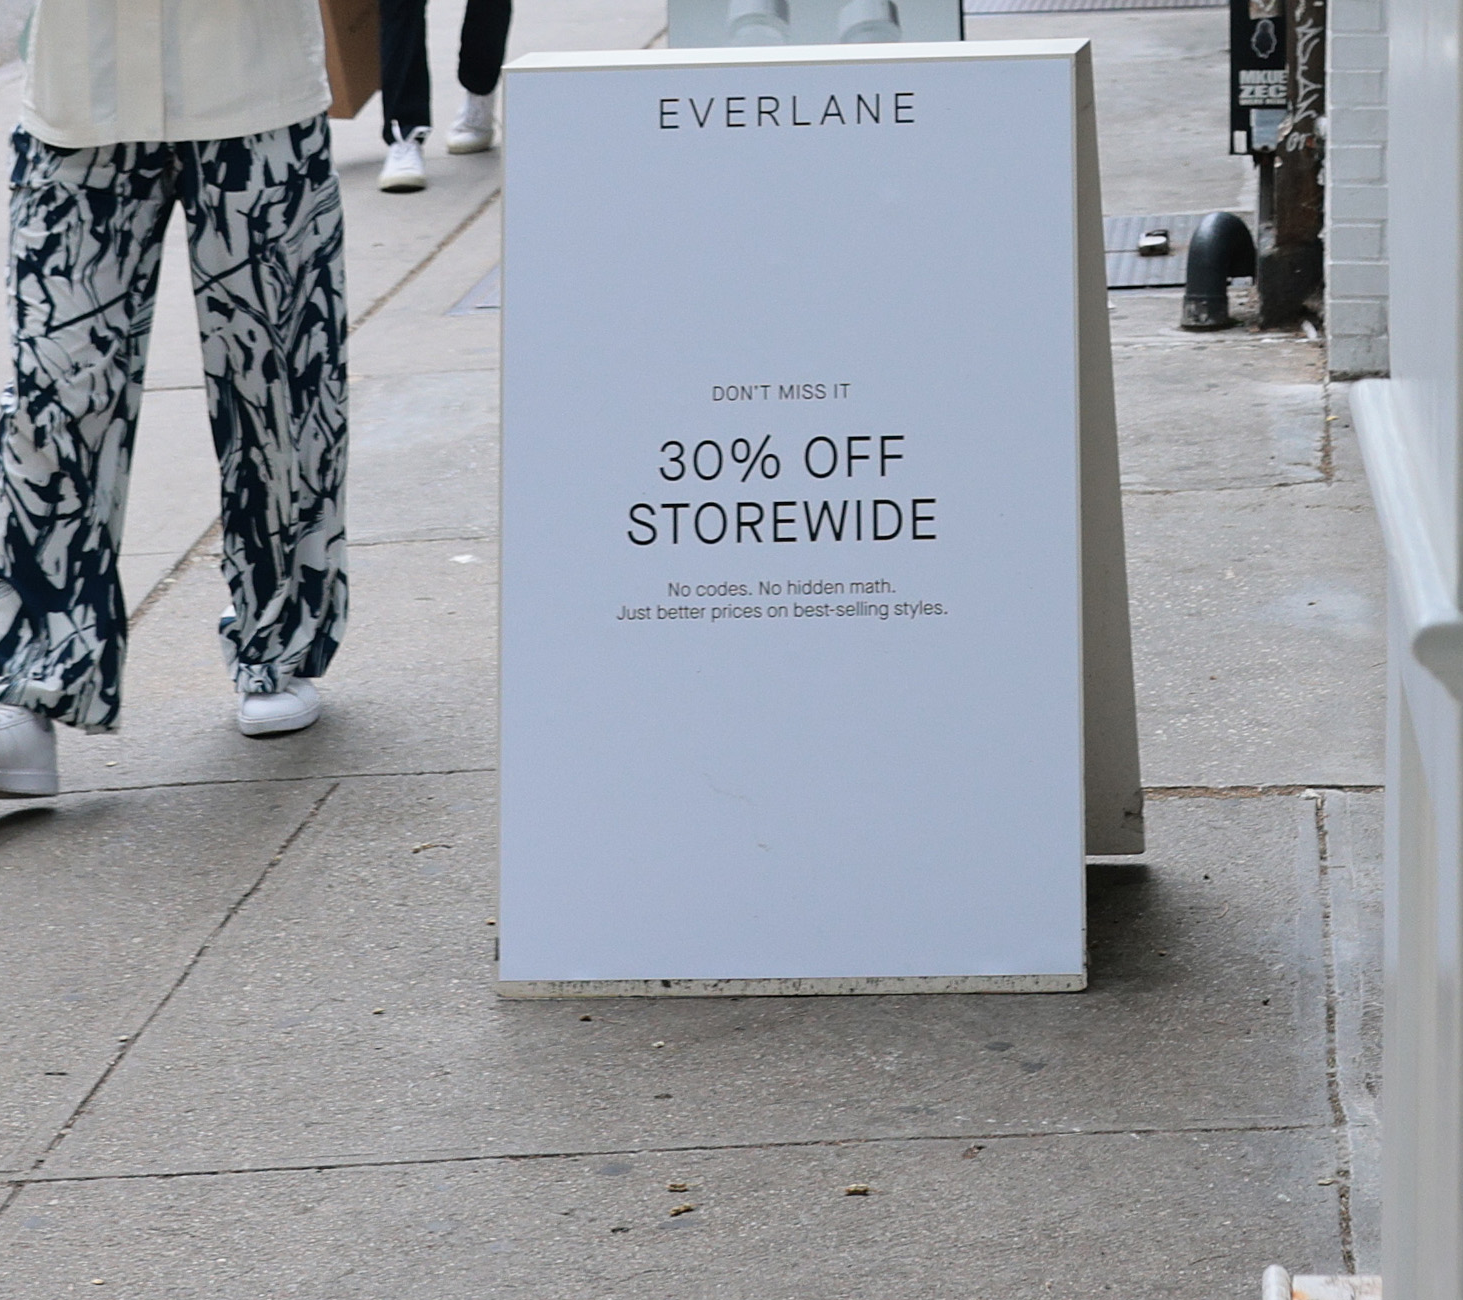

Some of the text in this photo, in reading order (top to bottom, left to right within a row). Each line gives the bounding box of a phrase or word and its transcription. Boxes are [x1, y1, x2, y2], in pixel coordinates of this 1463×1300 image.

[659, 92, 916, 130] EVERLANE
[712, 383, 851, 401] DON'T MISS IT
[659, 434, 905, 482] 30% OFF
[627, 498, 937, 546] STOREWIDE
[668, 579, 896, 597] No codes. No hidden math.
[617, 601, 949, 622] Just better prices on best-selling styles.
